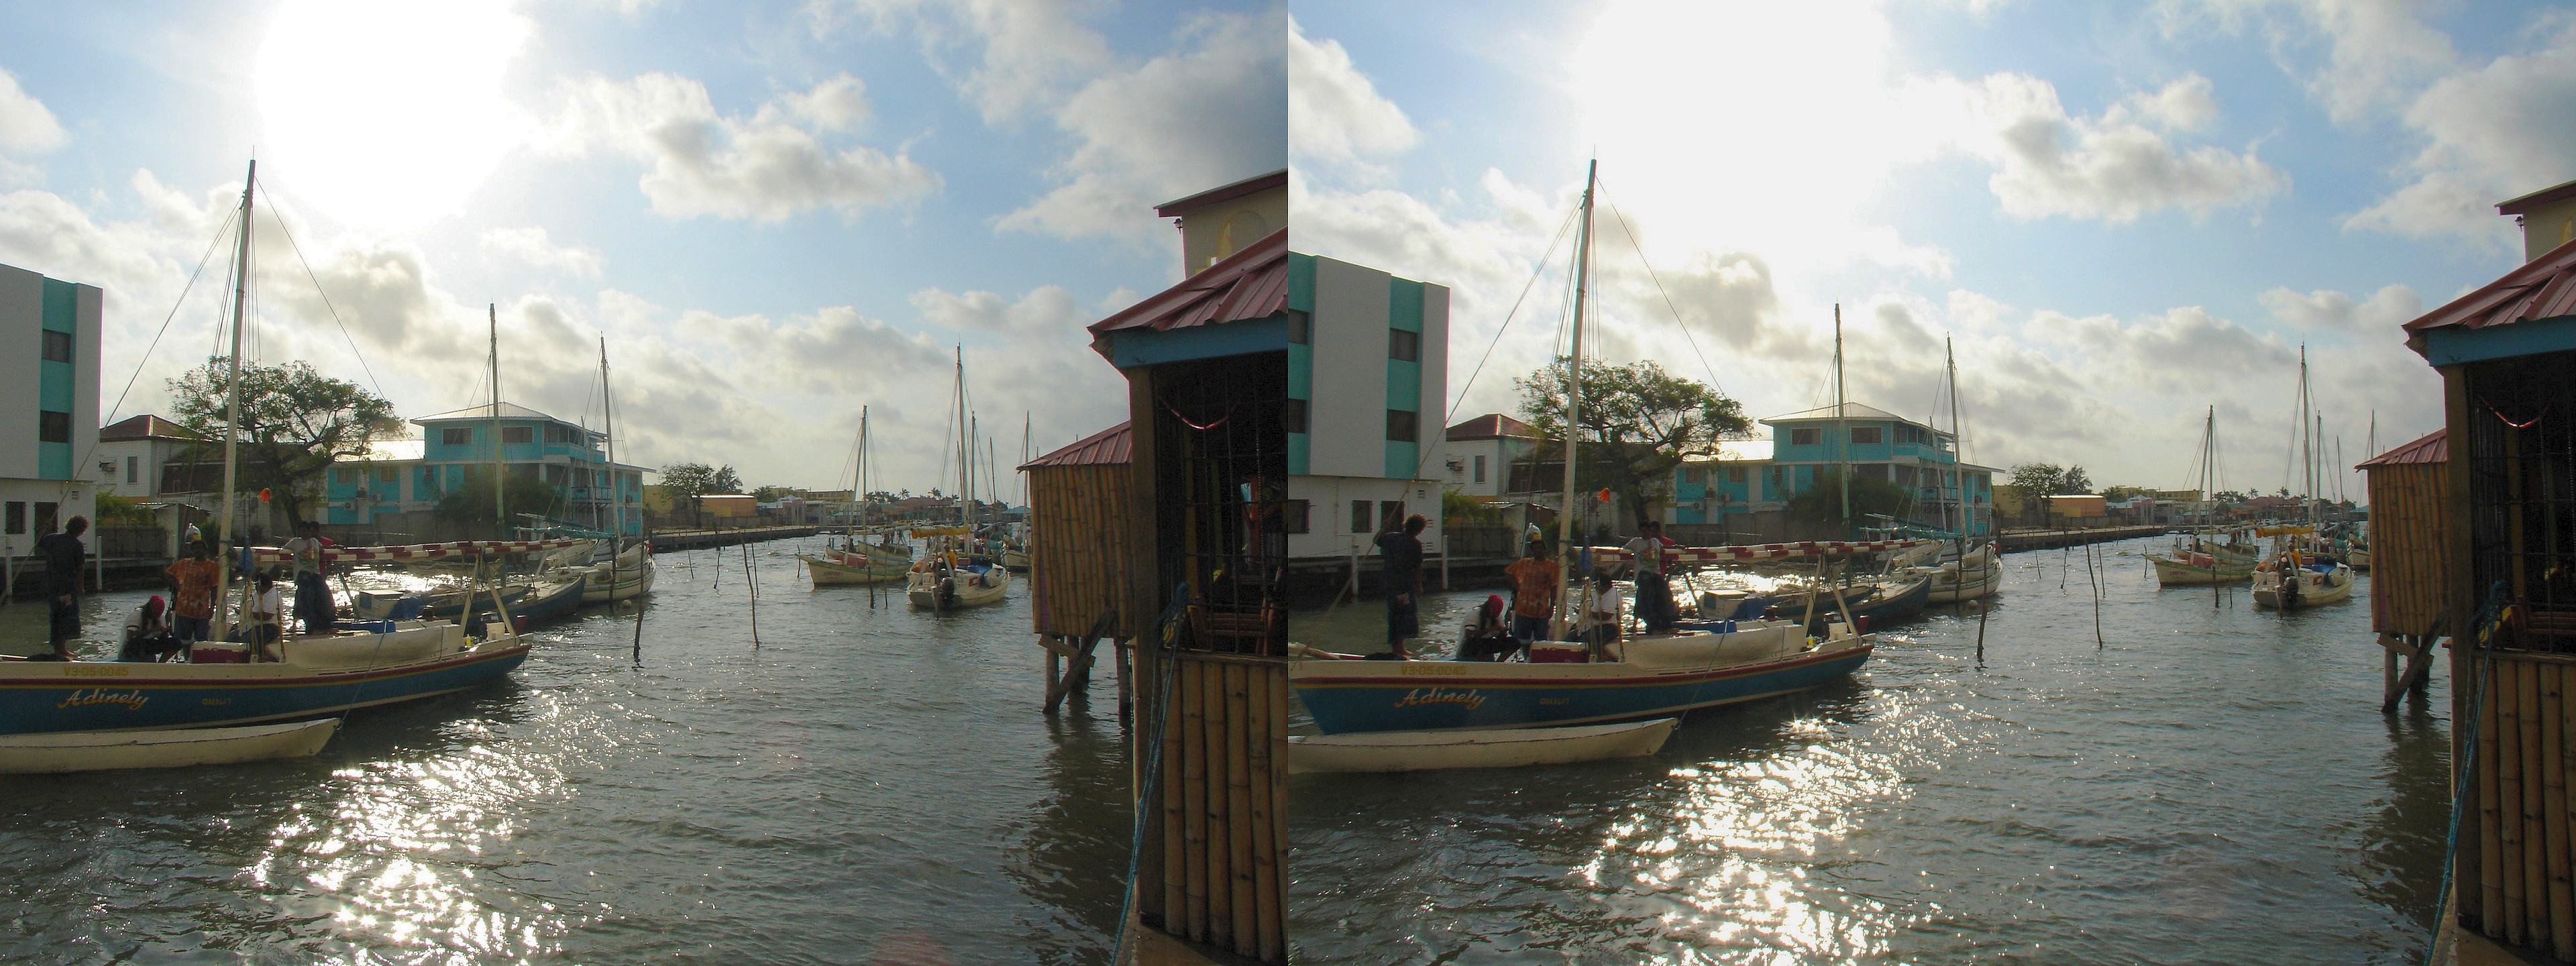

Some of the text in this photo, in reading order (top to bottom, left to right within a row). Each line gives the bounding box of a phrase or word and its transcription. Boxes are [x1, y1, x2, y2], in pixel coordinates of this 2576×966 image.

[64, 666, 129, 676] V3-05-0045
[1401, 665, 1466, 676] V3-05-0045
[56, 688, 149, 710] Adinely
[1393, 687, 1487, 710] Adinely
